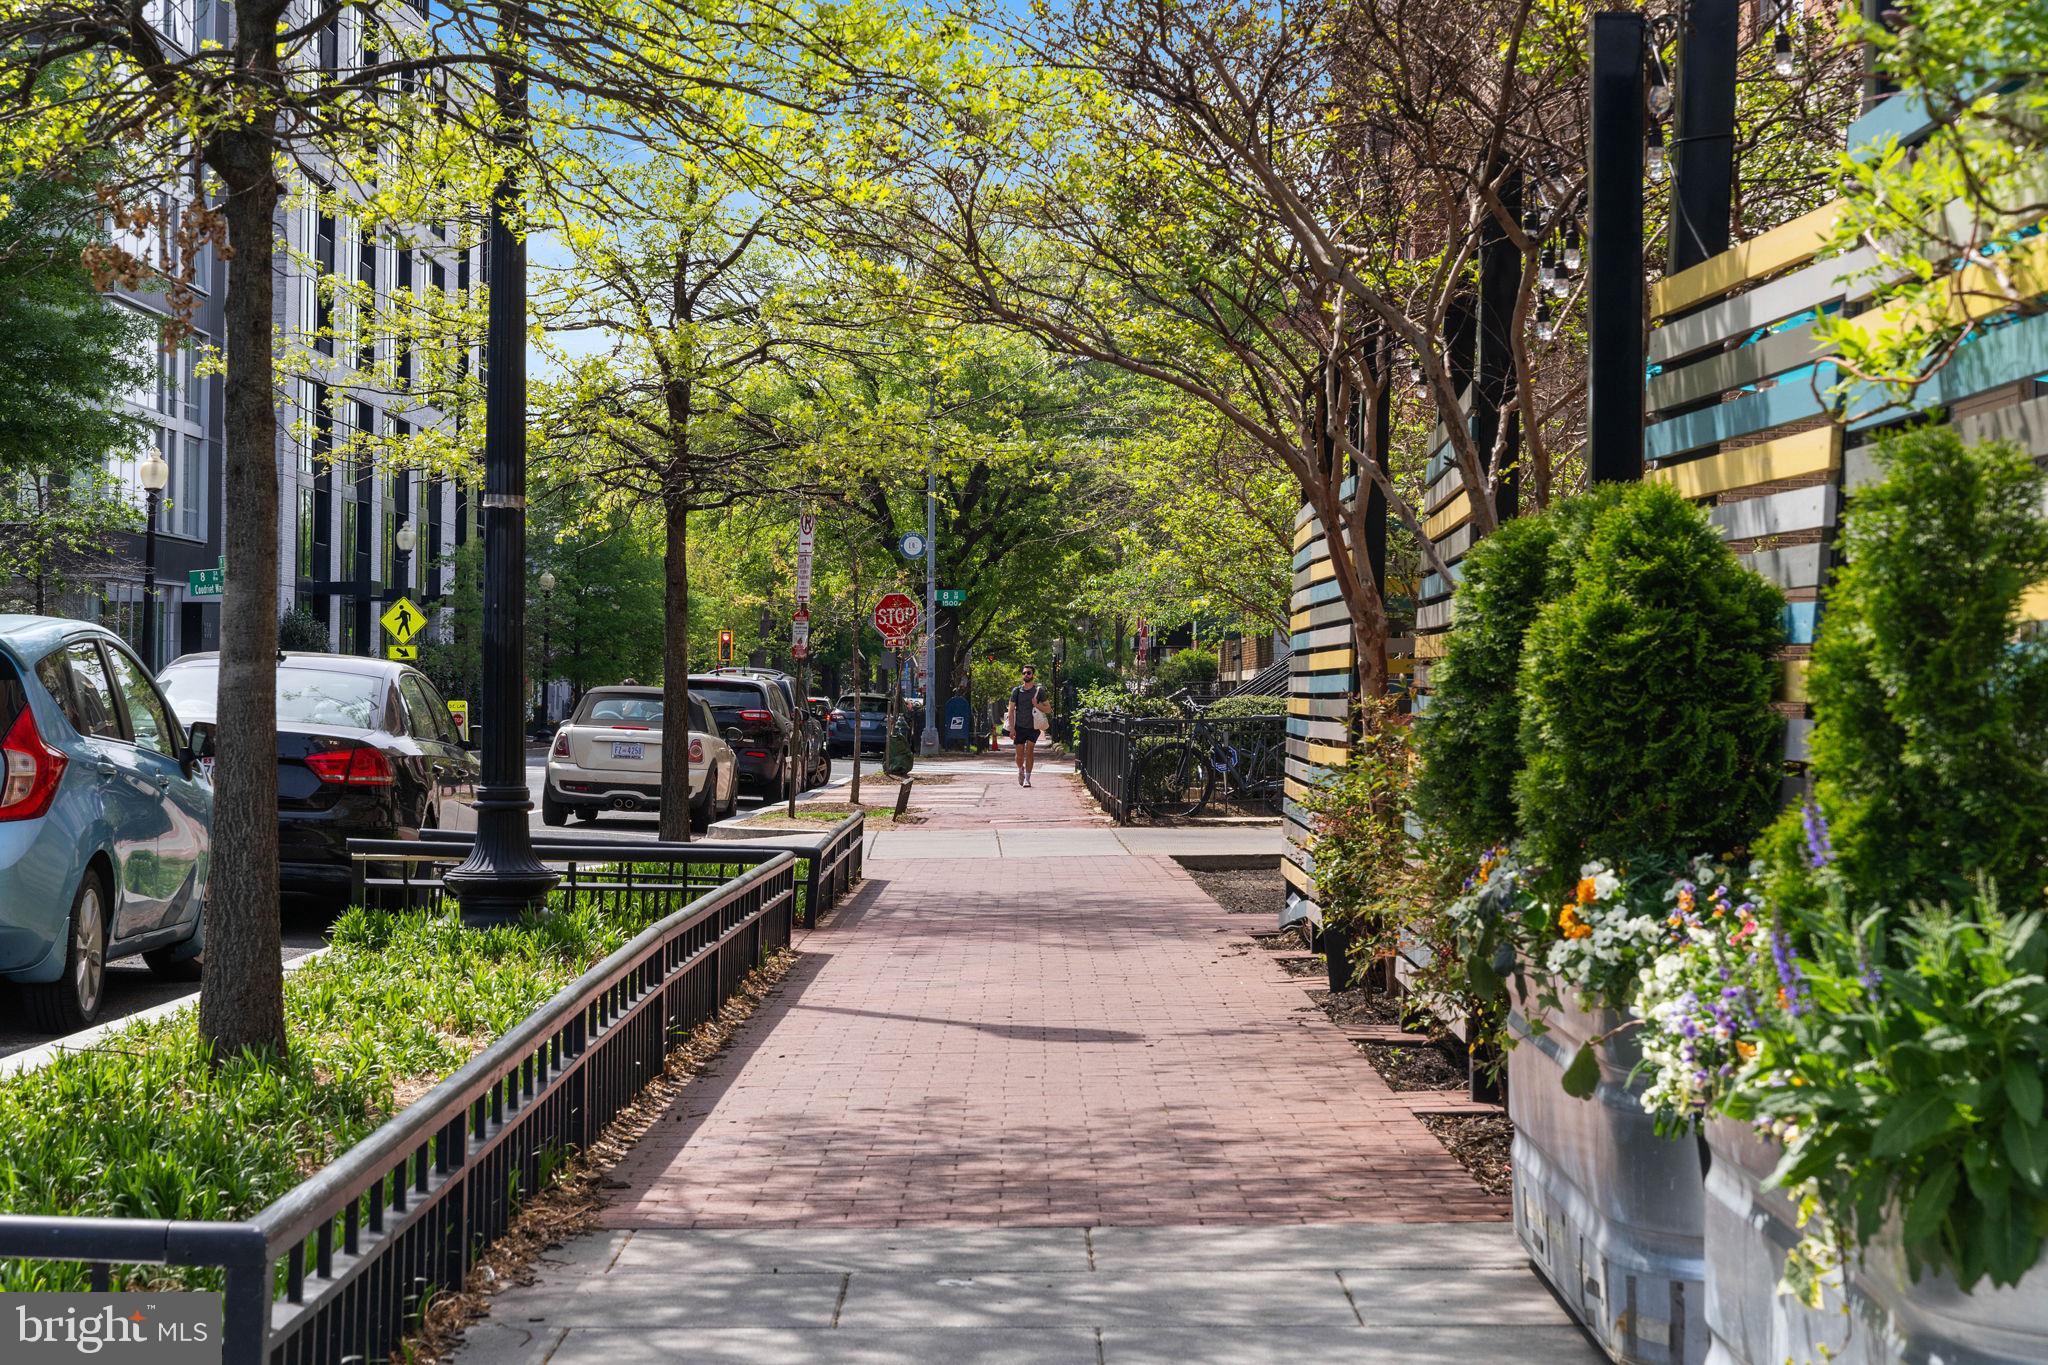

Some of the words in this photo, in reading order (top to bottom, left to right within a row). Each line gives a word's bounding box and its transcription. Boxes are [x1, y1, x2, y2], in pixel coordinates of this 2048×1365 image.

[200, 571, 206, 582] 8
[943, 591, 949, 600] 8
[878, 607, 915, 625] STOP
